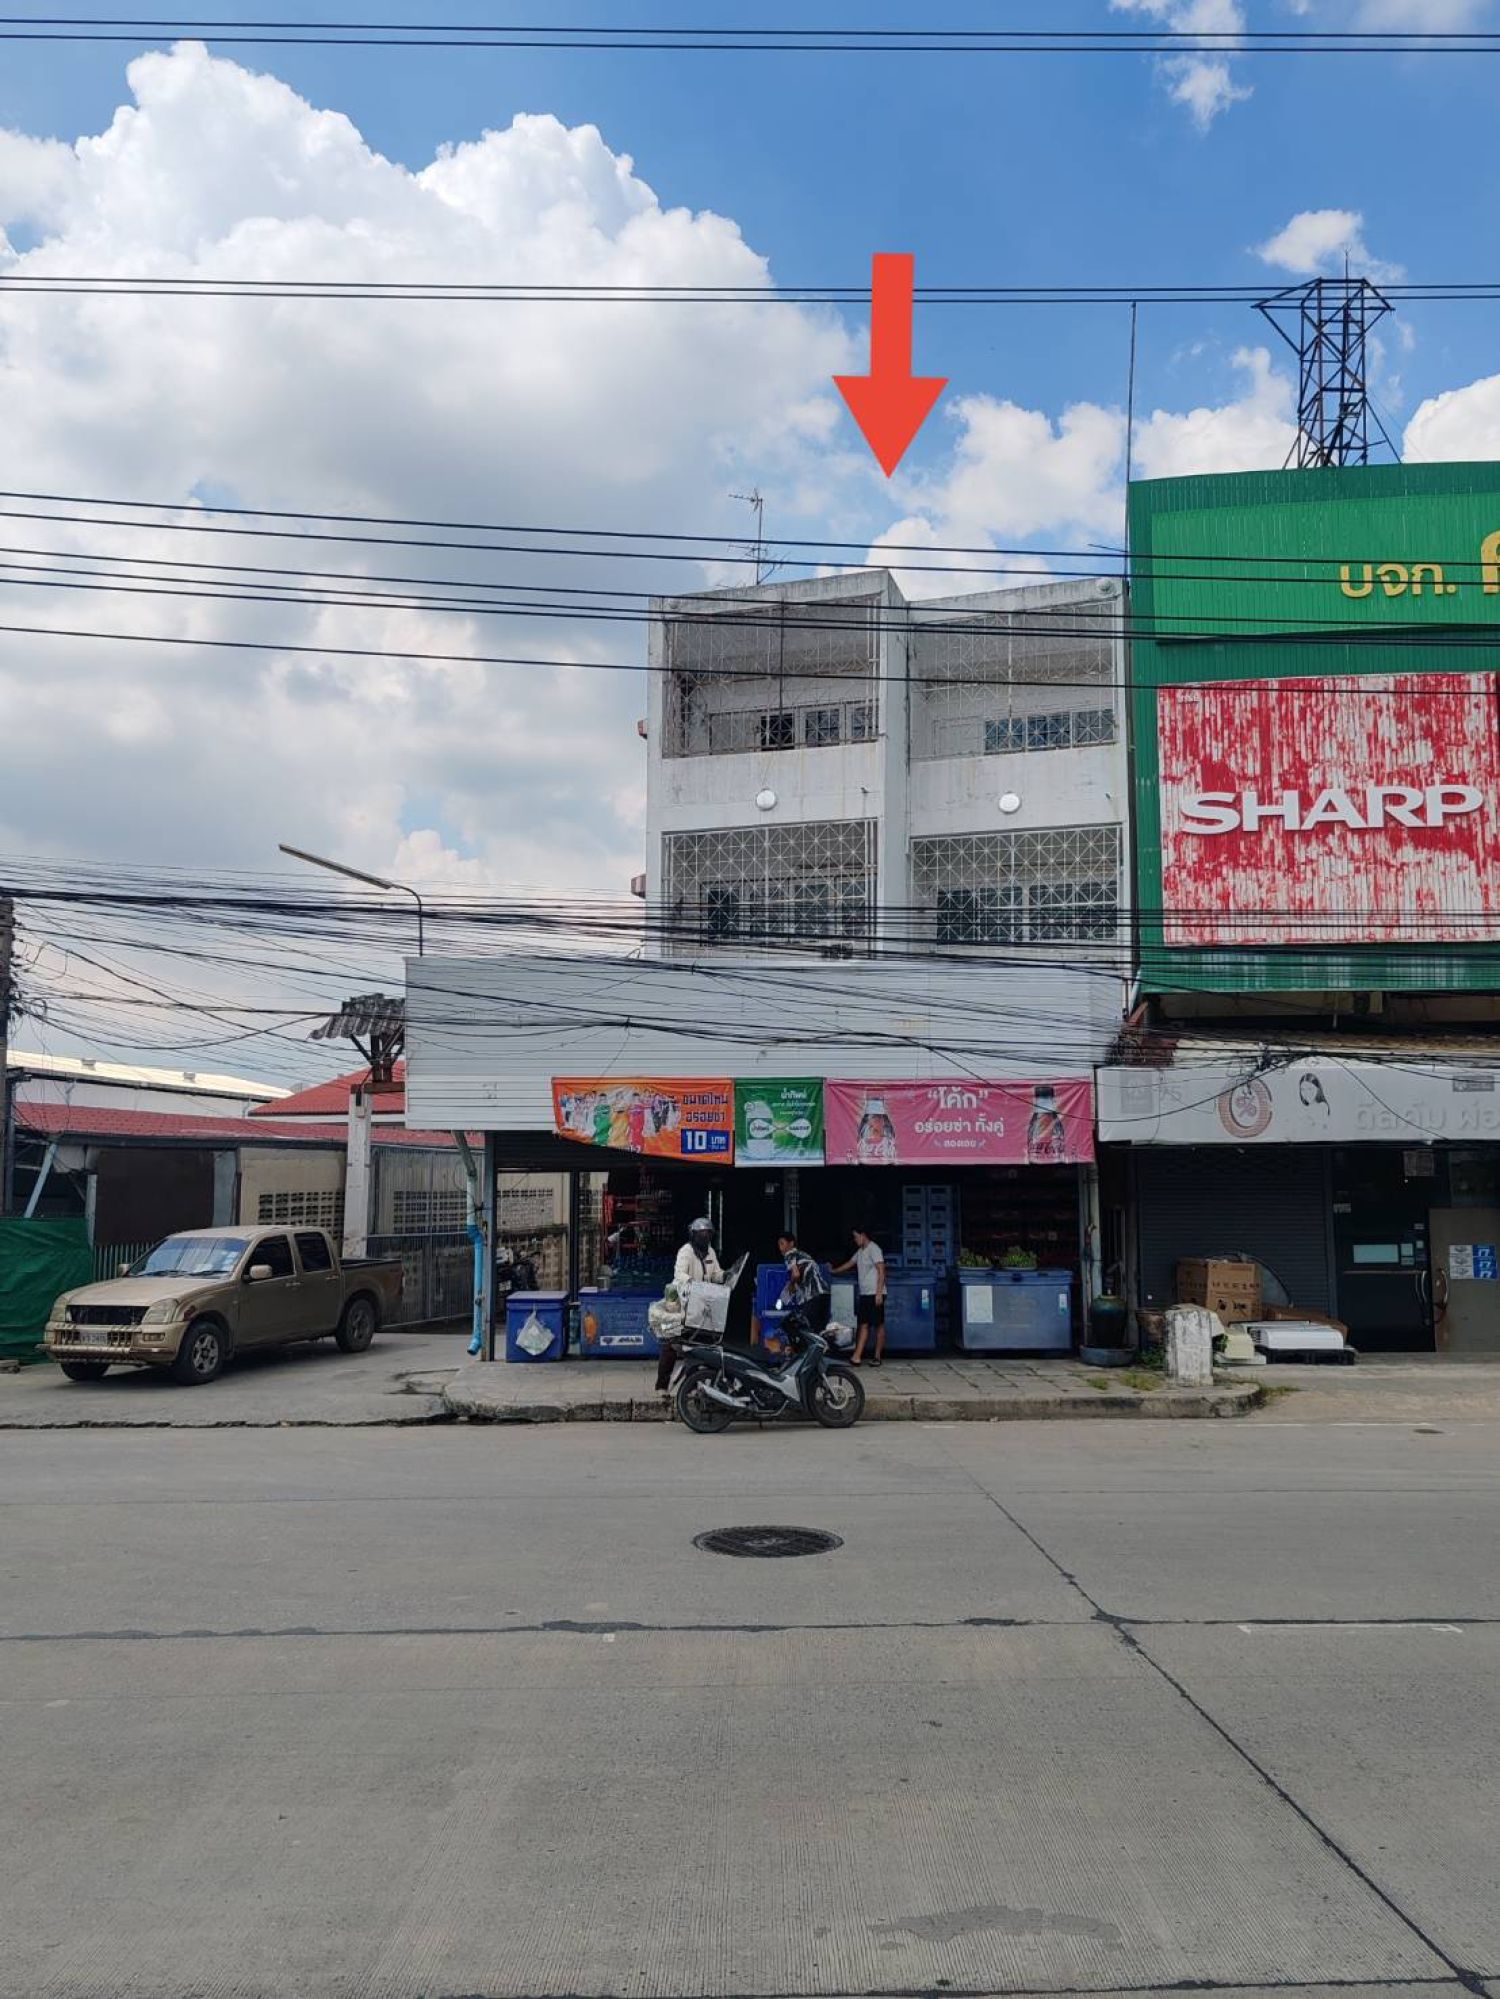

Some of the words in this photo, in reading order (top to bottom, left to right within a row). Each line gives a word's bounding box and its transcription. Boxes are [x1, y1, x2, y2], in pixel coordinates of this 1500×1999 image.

[1339, 561, 1457, 598] บจก.
[1180, 783, 1484, 836] SHARP
[685, 1130, 708, 1151] 10
